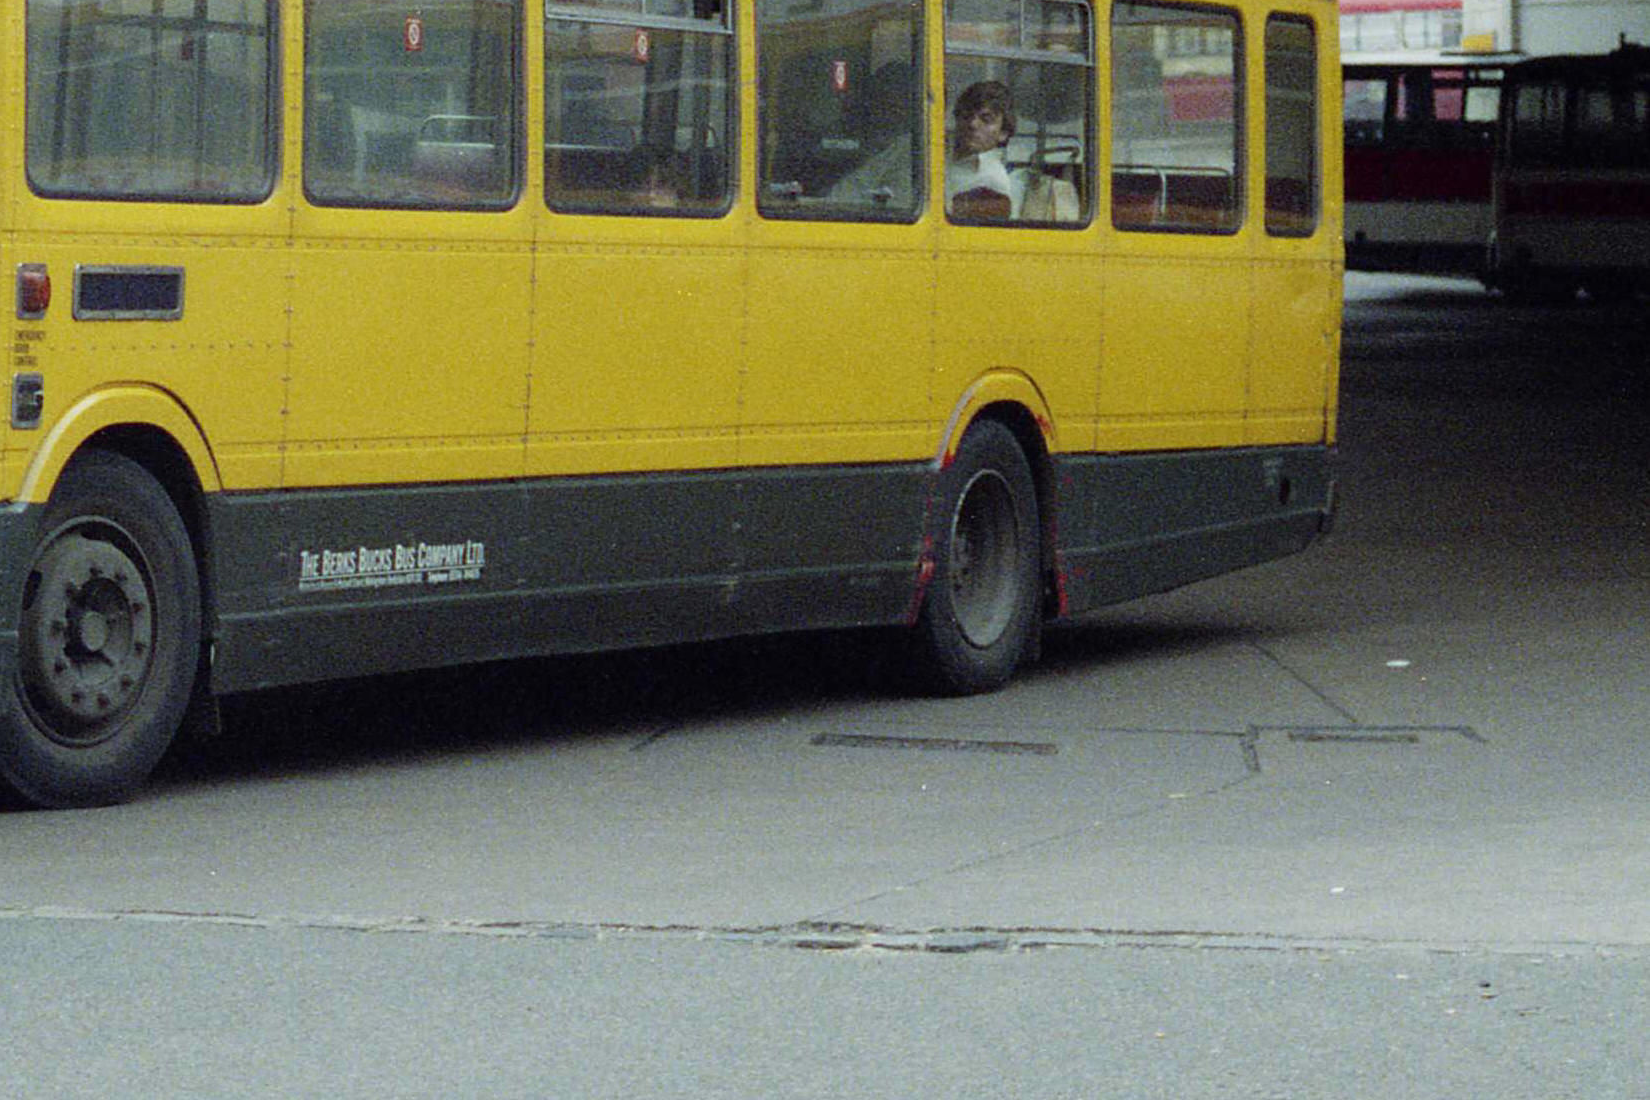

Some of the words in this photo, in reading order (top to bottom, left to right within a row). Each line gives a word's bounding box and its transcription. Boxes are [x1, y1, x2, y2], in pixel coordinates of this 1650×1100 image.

[300, 549, 320, 578] THE
[322, 549, 357, 576] BERKS
[359, 546, 392, 573] BUCKS
[395, 543, 416, 570] BUS
[418, 541, 464, 568] COMPANY
